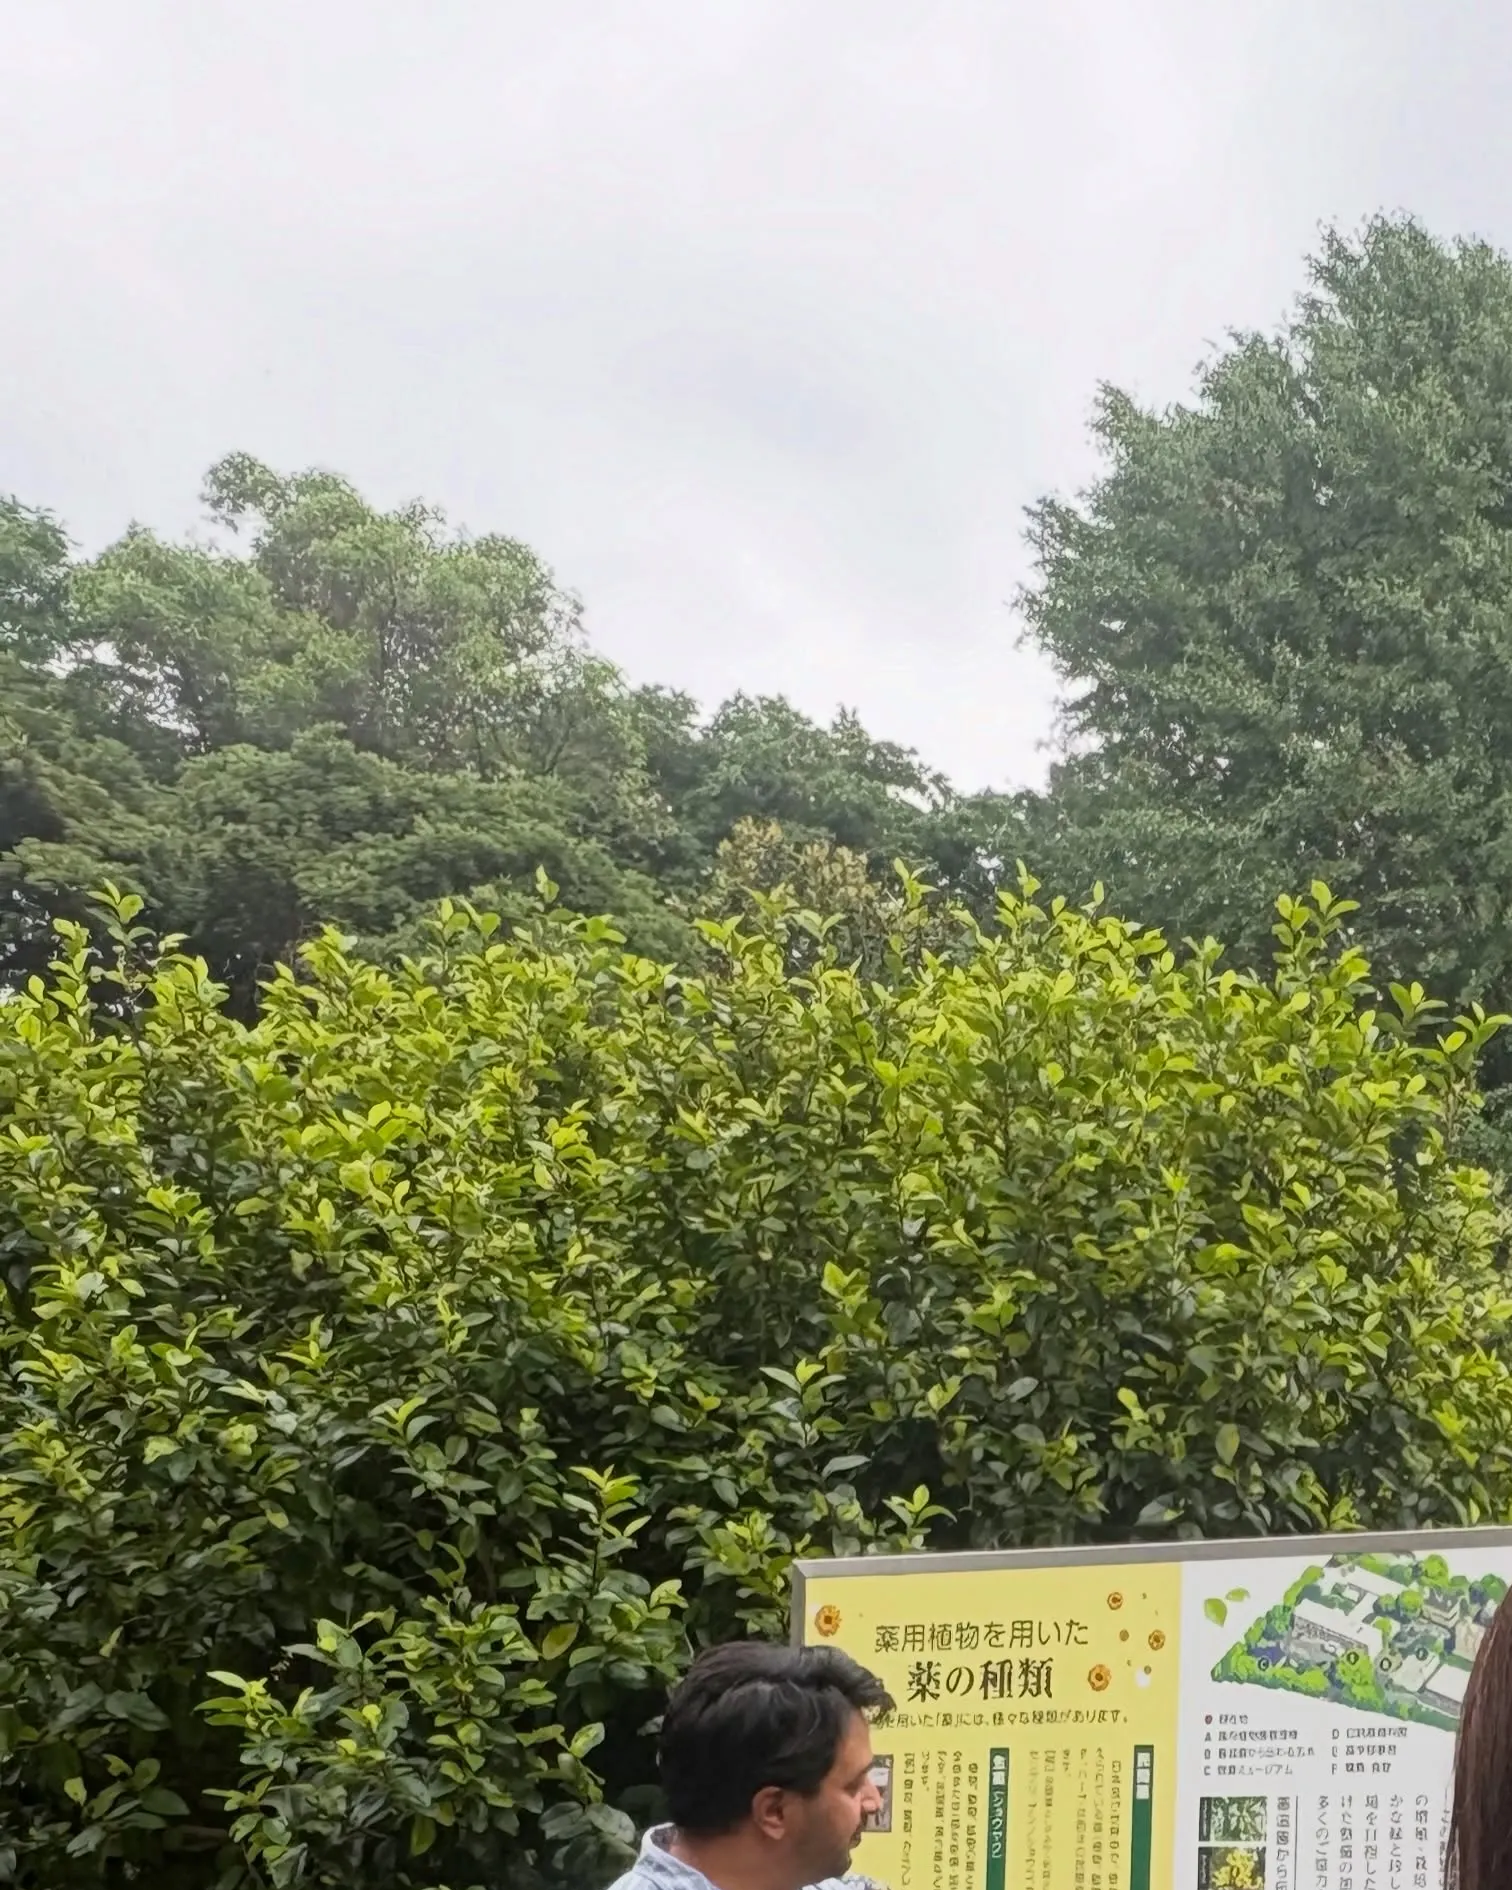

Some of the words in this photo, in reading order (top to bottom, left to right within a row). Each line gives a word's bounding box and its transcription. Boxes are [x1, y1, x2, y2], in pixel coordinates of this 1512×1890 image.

[874, 1618, 1089, 1653] 薬用植物を用いた
[907, 1657, 1053, 1702] 薬の種類
